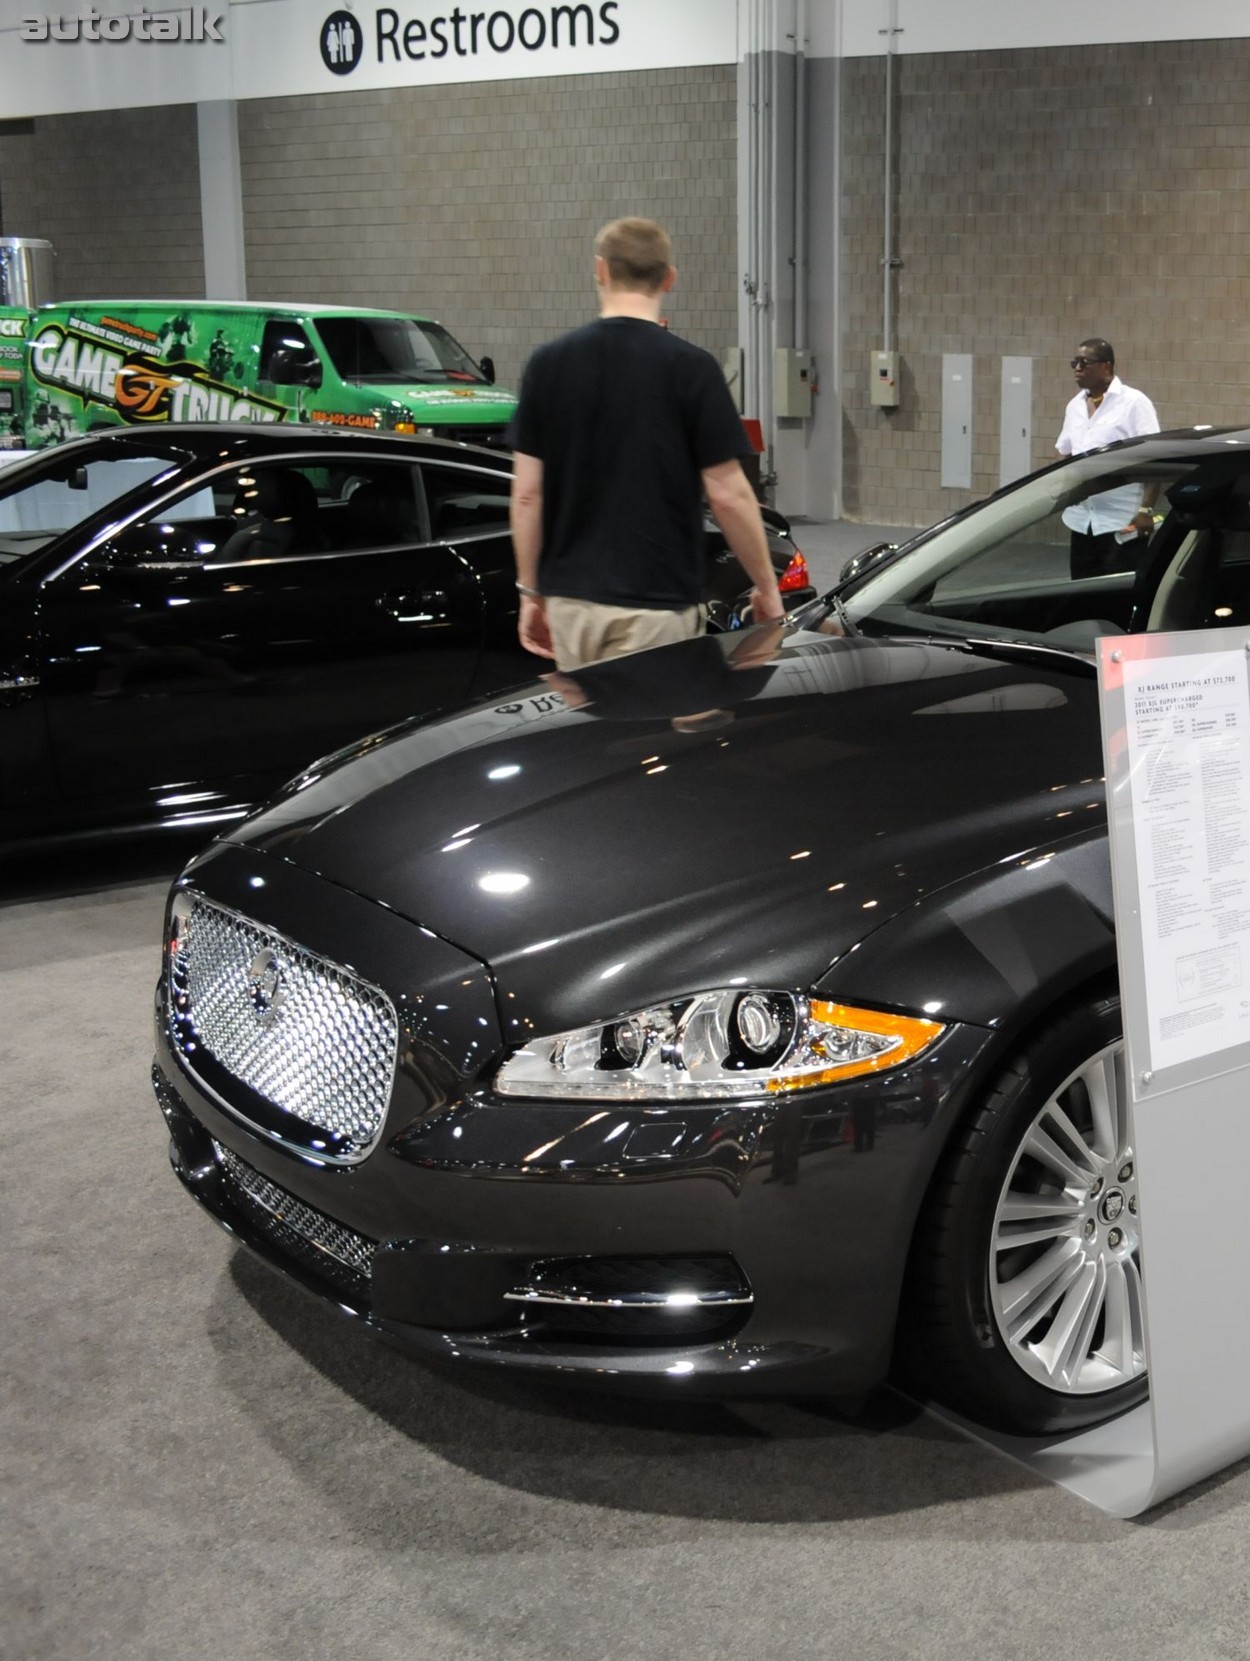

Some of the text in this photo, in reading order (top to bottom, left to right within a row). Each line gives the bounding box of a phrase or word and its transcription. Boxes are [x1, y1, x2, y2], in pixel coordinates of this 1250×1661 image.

[376, 1, 620, 63] Restrooms
[0, 319, 22, 337] CK
[123, 336, 142, 350] GAME
[141, 343, 162, 357] PARTY
[33, 328, 124, 398] GAME
[1147, 683, 1169, 691] RANGE
[1171, 680, 1201, 689] STARTING
[1135, 706, 1164, 715] STARTING
